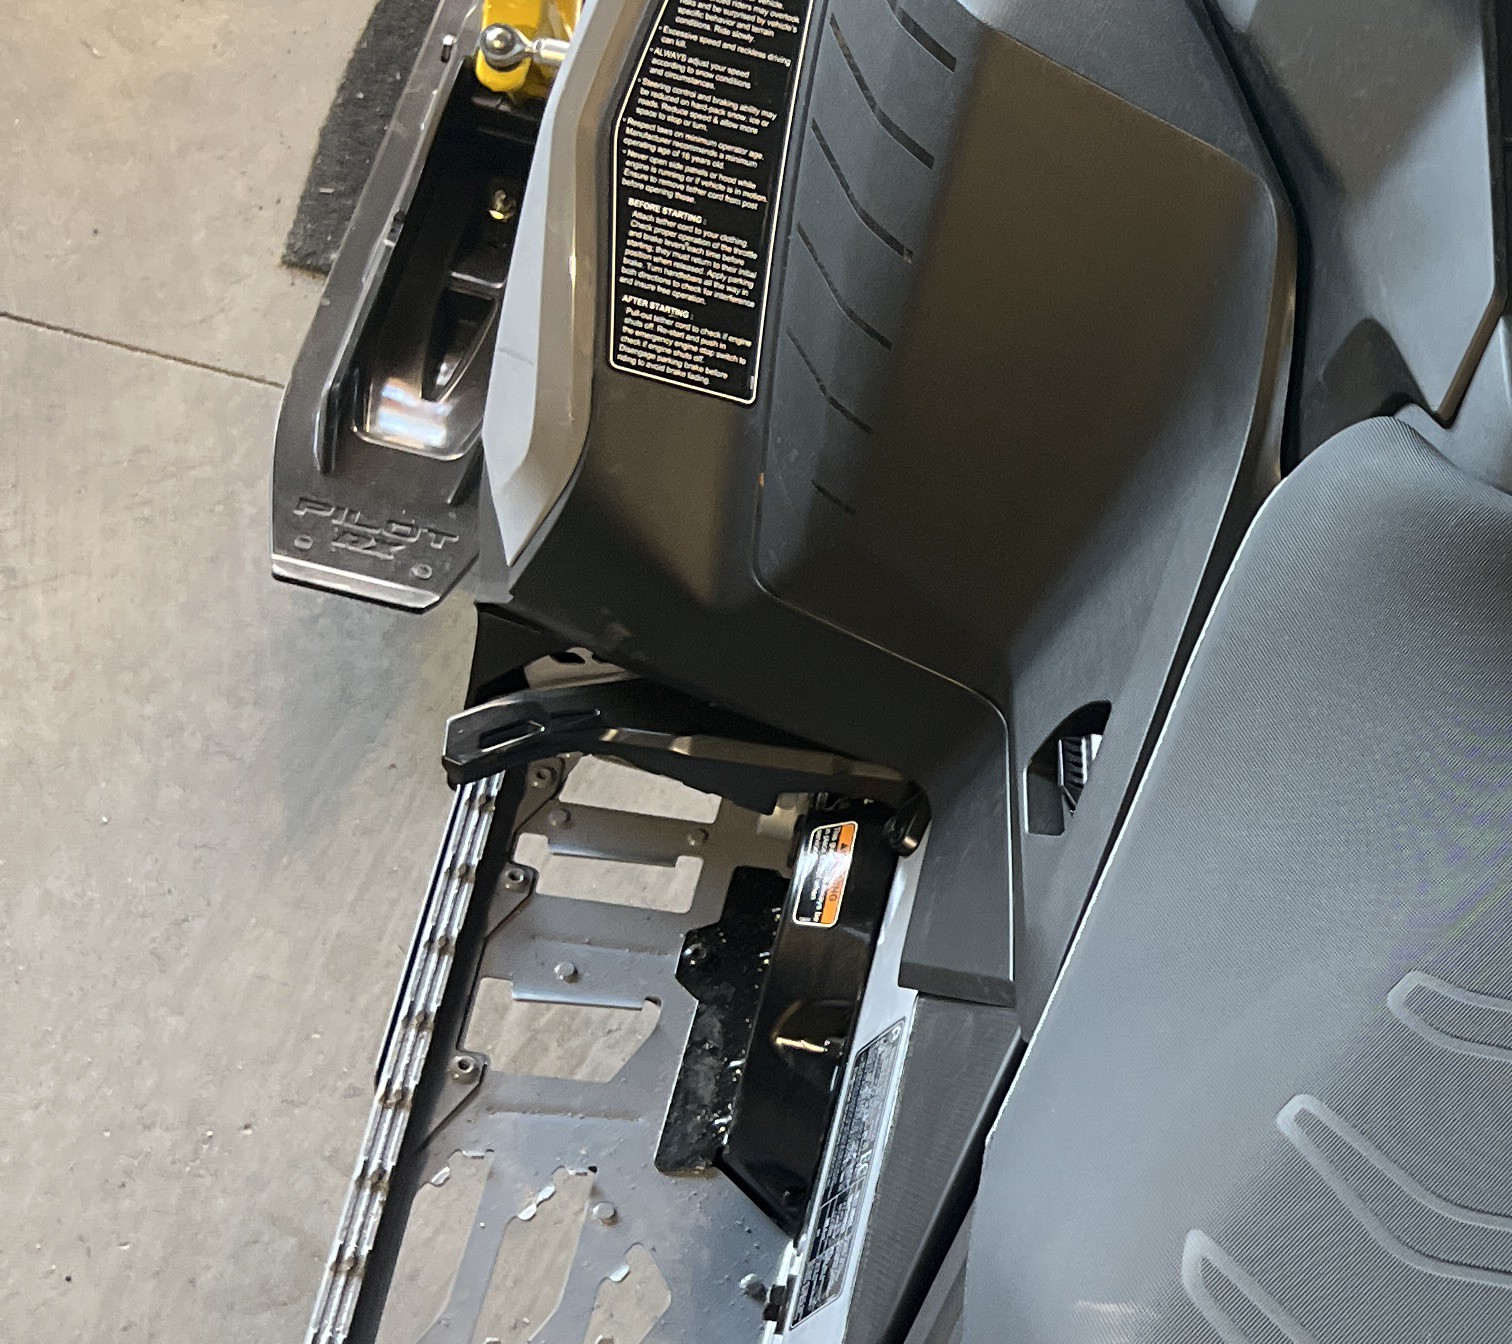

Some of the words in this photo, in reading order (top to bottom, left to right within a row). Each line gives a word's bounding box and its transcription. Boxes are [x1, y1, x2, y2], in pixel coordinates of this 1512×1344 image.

[627, 197, 662, 213] BEFORE
[661, 206, 702, 224] STARTING
[621, 294, 649, 308] AFTER
[649, 301, 690, 318] STARTING
[293, 497, 459, 549] PILOT
